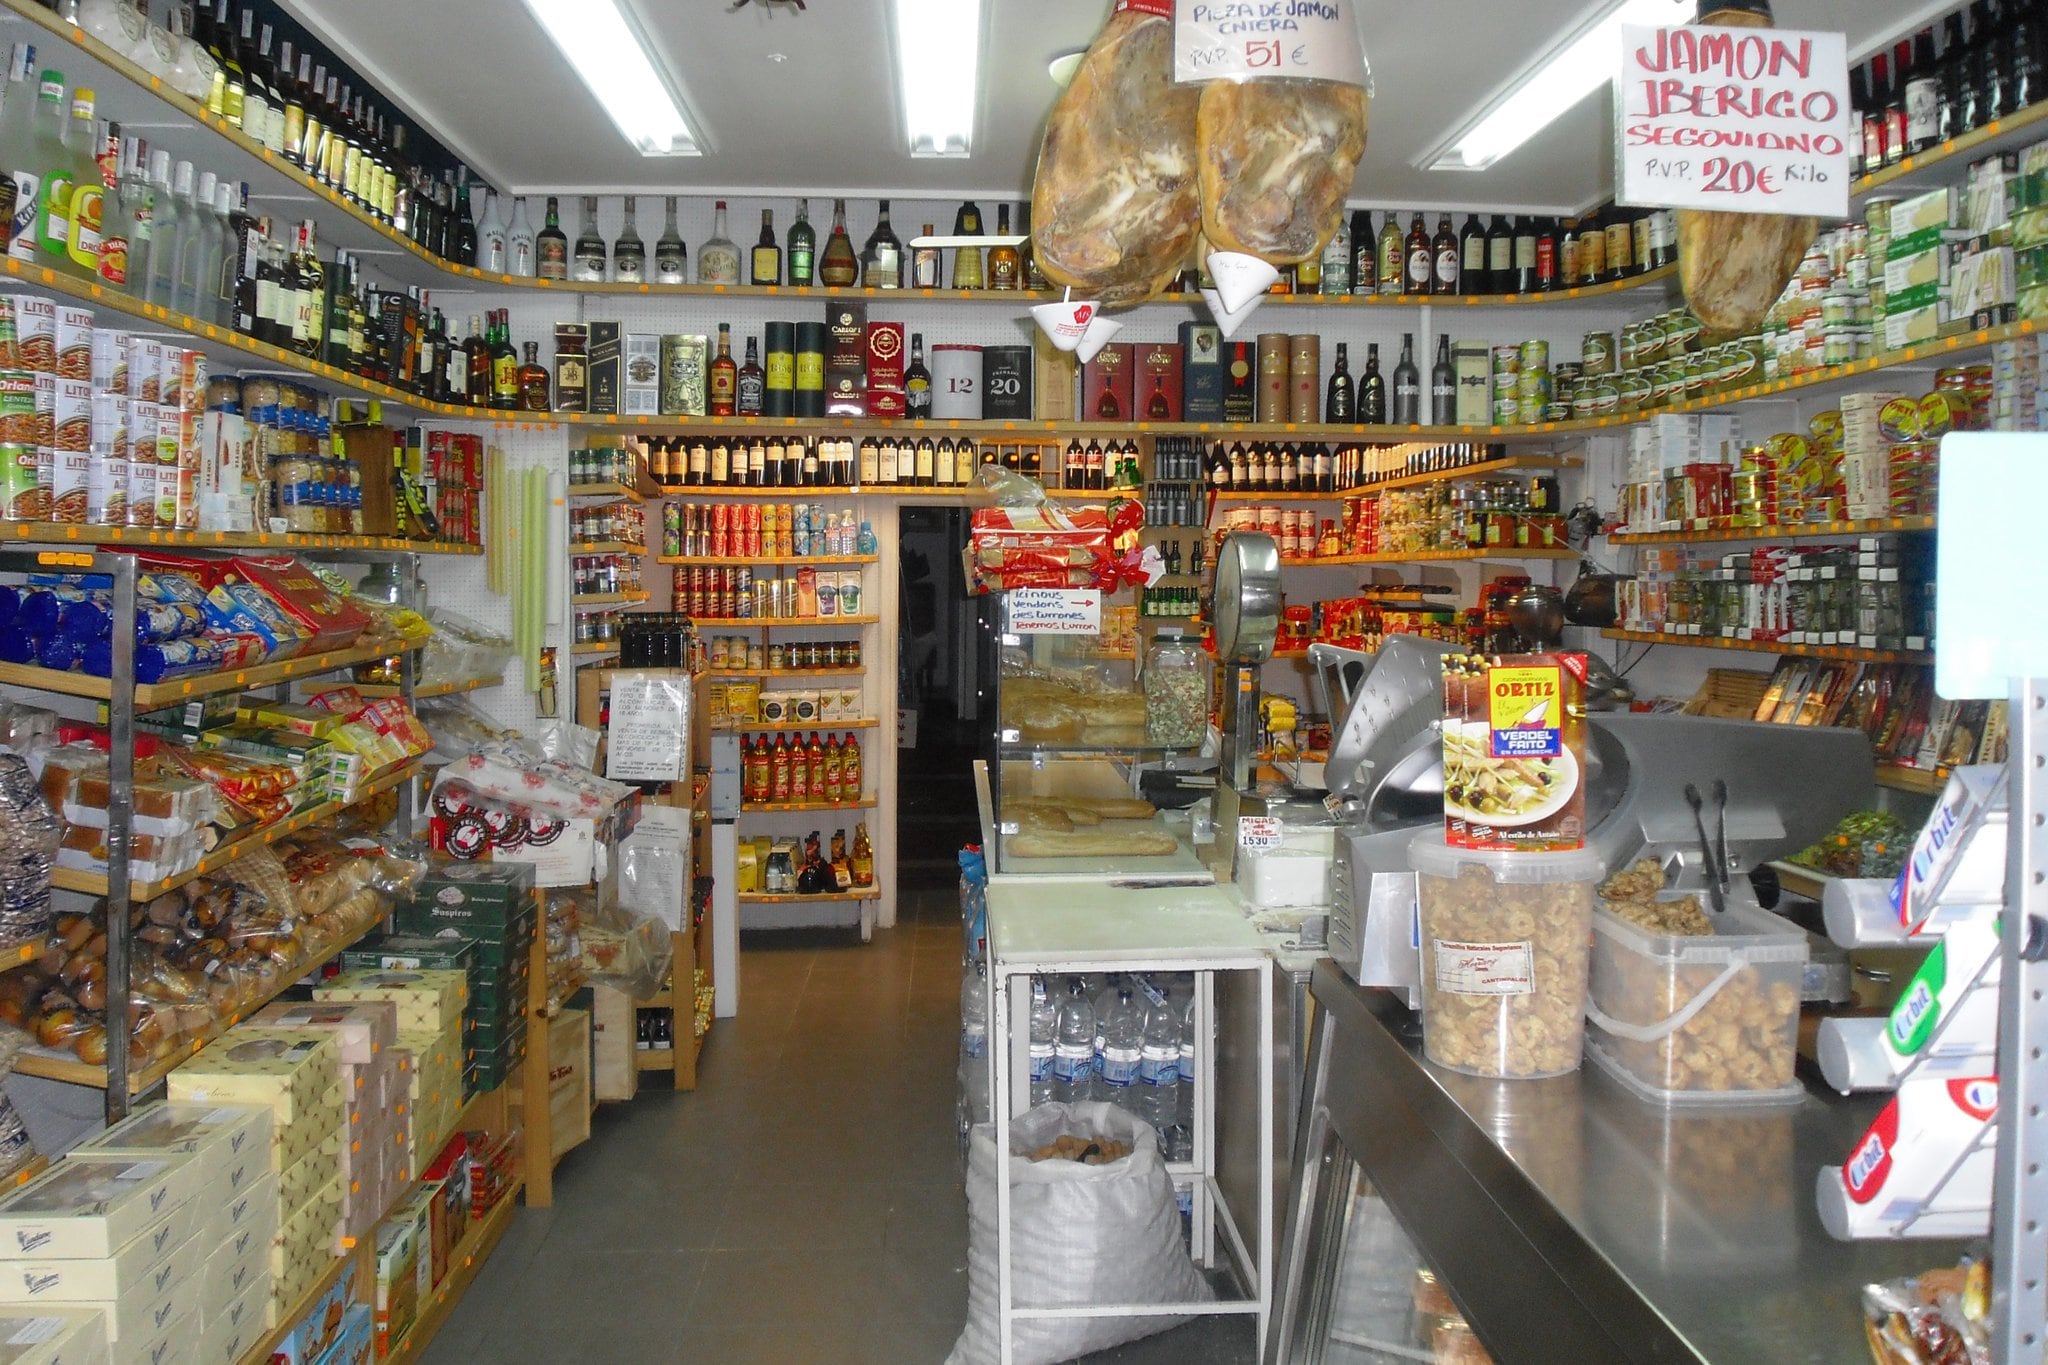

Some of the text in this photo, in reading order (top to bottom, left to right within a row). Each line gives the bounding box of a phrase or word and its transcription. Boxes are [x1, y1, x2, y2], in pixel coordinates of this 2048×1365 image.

[1193, 0, 1340, 22] PIEZA DE JAMON
[1245, 39, 1283, 68] 51
[1291, 44, 1309, 66] €
[1635, 28, 1812, 80] JAMON
[1626, 123, 1844, 156] SEGOVIANO
[1646, 156, 1829, 194] P.V.P. 20€ Kilo
[946, 377, 974, 394] 12
[990, 377, 1021, 395] 20
[1031, 591, 1064, 600] nous
[1012, 600, 1064, 609] vendons
[1012, 610, 1086, 621] des turrones
[1013, 621, 1097, 631] Tenemos turron
[1495, 682, 1555, 697] ORTIZ
[1500, 730, 1554, 741] VERDEL
[1508, 740, 1547, 749] FRITO
[1912, 804, 1957, 884] Orbit
[431, 906, 472, 919] Suspiros
[1895, 986, 1929, 1040] Orbit
[1850, 1137, 1883, 1188] Orbit
